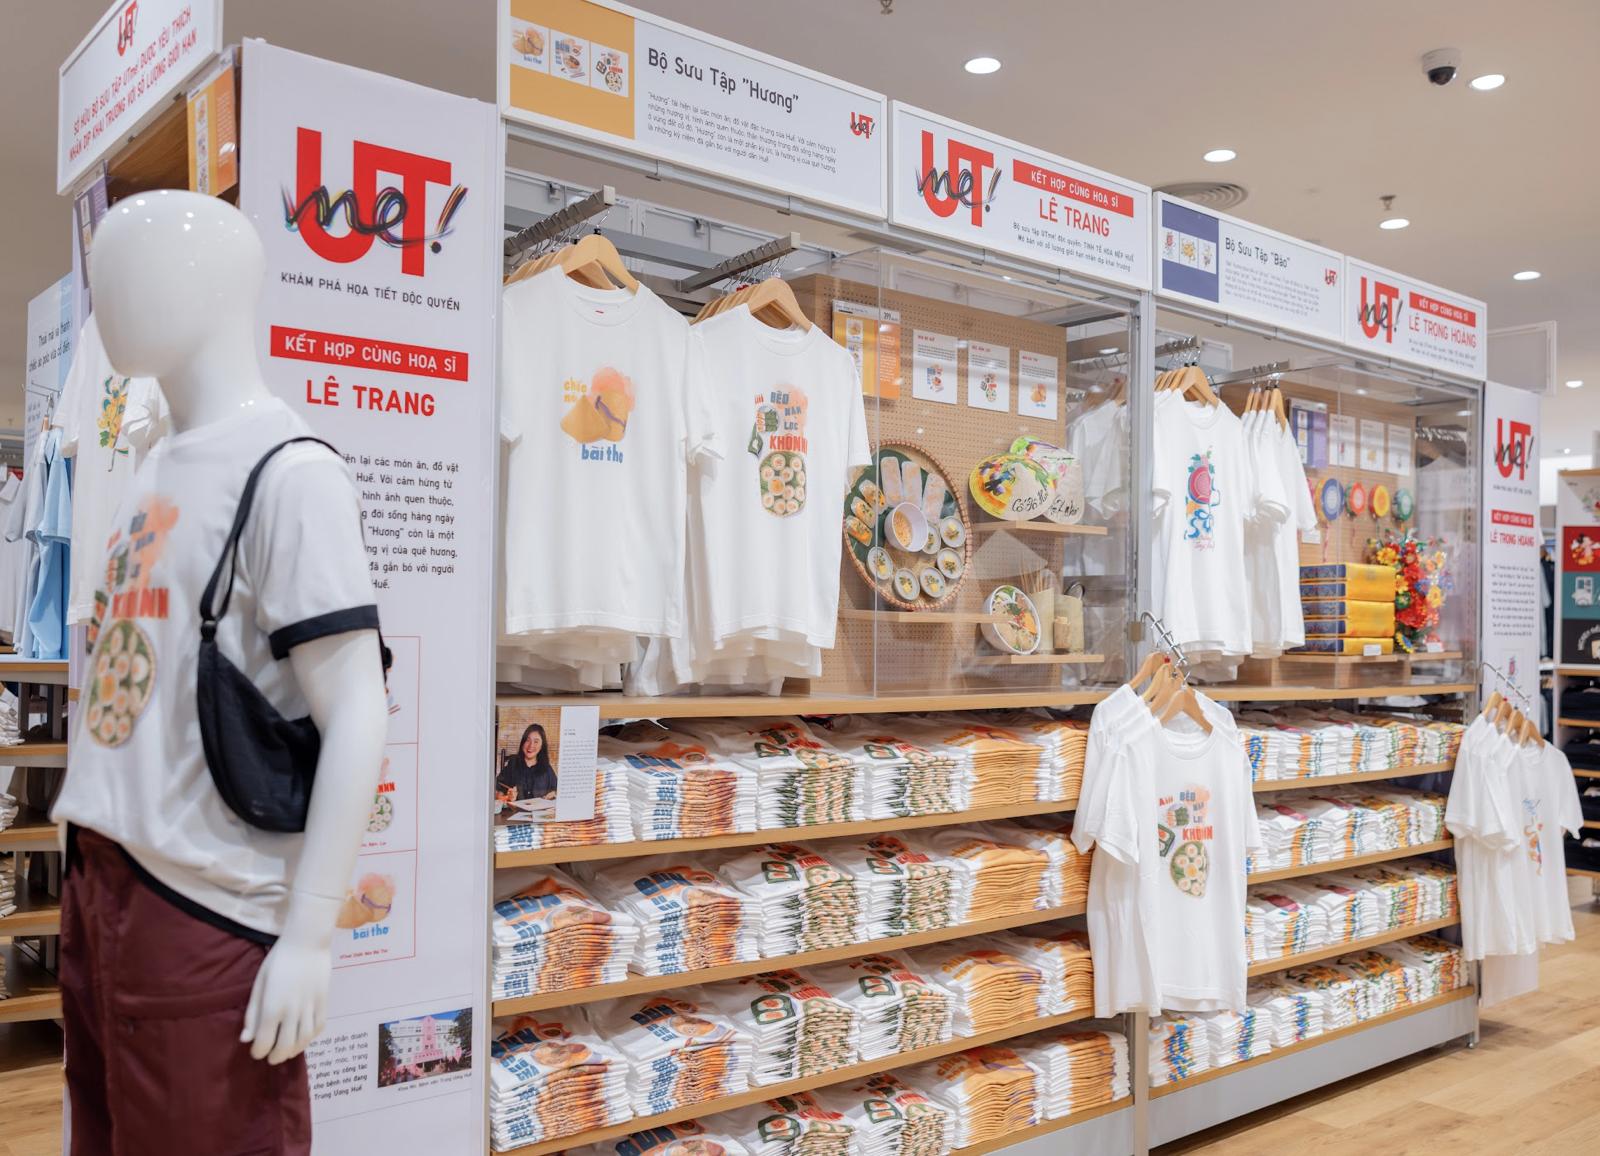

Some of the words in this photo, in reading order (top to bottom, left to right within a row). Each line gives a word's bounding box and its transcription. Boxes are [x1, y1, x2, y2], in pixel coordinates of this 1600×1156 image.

[648, 48, 668, 74] Bộ
[675, 56, 703, 81] Sưu
[710, 67, 736, 95] Tập
[851, 112, 873, 139] UT
[921, 130, 994, 228] UT
[1031, 170, 1047, 185] KẾT
[1050, 177, 1066, 192] HỢP
[1069, 183, 1090, 199] CÙNG
[1093, 191, 1109, 206] HOẠ
[297, 126, 451, 277] UT
[1040, 197, 1058, 223] LÊ
[1064, 206, 1110, 237] TRANG
[1225, 237, 1235, 253] Bộ
[1238, 241, 1252, 258] Sưu
[1255, 246, 1268, 264] Tập
[281, 271, 314, 287] KHÁM
[319, 278, 342, 292] PHÁ
[374, 286, 398, 301] TIẾT
[402, 291, 422, 306] ĐỘC
[427, 296, 460, 311] QUYỀN
[1360, 276, 1399, 344] UT
[1409, 313, 1420, 332] LÊ
[285, 333, 317, 354] KẾT
[324, 340, 355, 360] HỢP
[362, 344, 402, 365] CÙNG
[409, 352, 437, 373] HOẠ
[444, 355, 457, 373] SĨ
[306, 375, 340, 406] LÊ
[352, 385, 435, 417] TRANG
[1497, 418, 1531, 480] UT
[360, 455, 371, 467] lại
[375, 457, 390, 467] các
[394, 458, 413, 469] món
[432, 461, 443, 472] đồ
[446, 463, 459, 475] vật
[362, 490, 381, 501] hình
[385, 492, 401, 502] ảnh
[404, 495, 425, 505] quen
[380, 474, 393, 485] Với
[396, 476, 415, 486] cảm
[418, 477, 440, 490] hứng
[443, 478, 452, 489] từ
[371, 508, 384, 519] đời
[388, 510, 407, 522] sống
[411, 511, 431, 524] hàng
[435, 513, 455, 525] ngày
[381, 544, 389, 556] vị
[392, 544, 408, 555] của
[411, 545, 427, 557] quê
[408, 529, 423, 539] còn
[427, 529, 435, 539] là
[438, 531, 455, 541] một
[383, 561, 399, 574] gắn
[402, 562, 413, 572] bó
[416, 562, 428, 573] với
[431, 564, 455, 576] người
